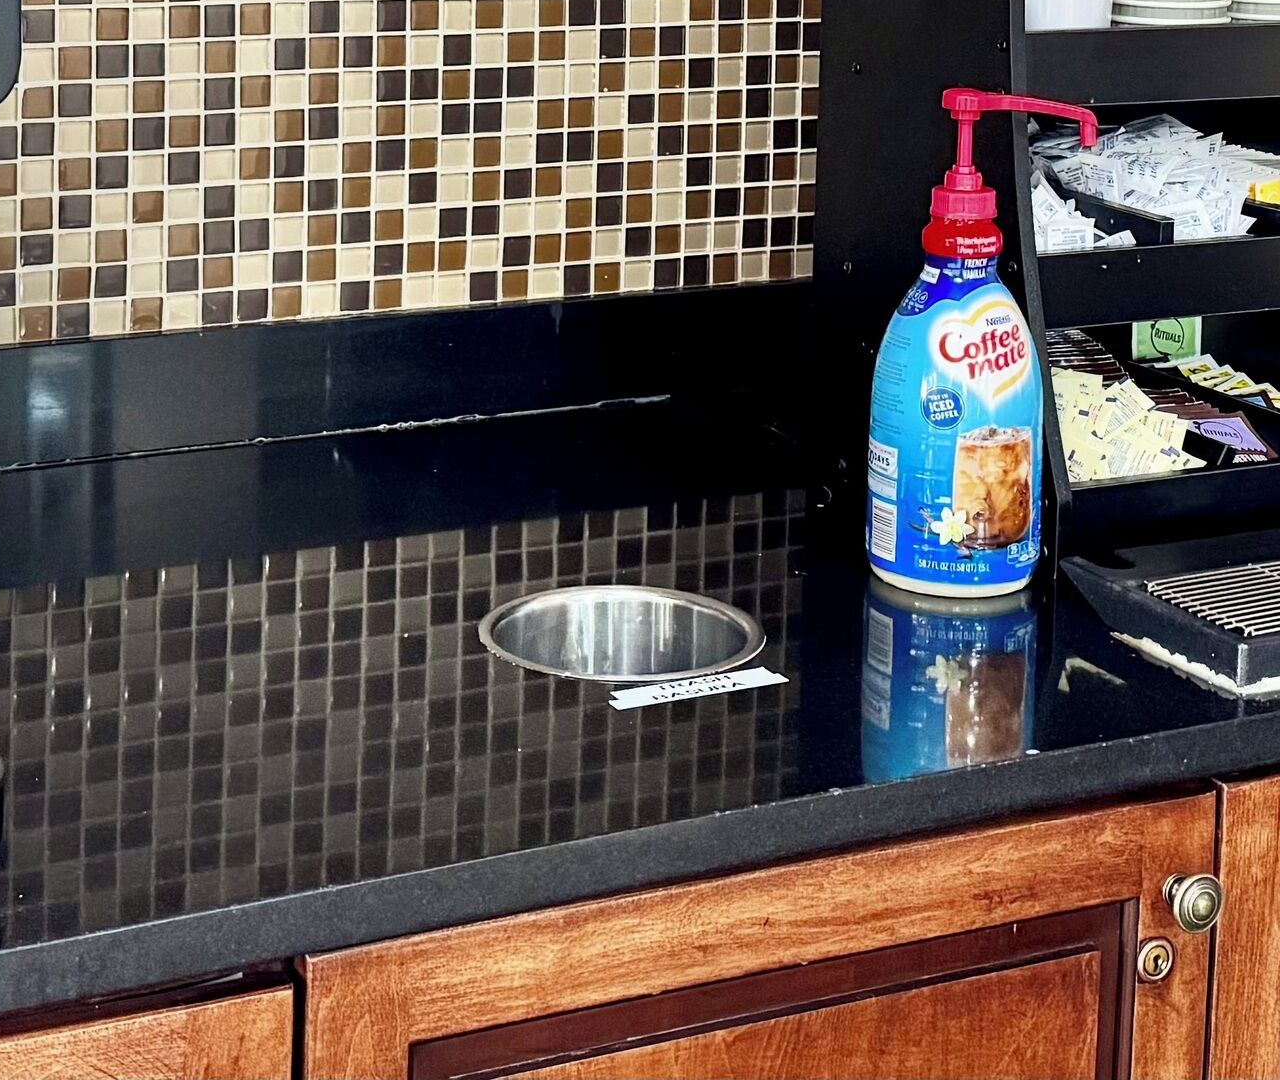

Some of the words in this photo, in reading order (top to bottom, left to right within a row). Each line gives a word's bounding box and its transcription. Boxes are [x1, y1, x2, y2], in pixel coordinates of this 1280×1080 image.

[1154, 327, 1182, 343] RITUALS
[938, 323, 1021, 364] Coffee
[967, 341, 1026, 380] mate
[928, 398, 955, 413] ICED
[930, 409, 959, 421] COFFEE
[1203, 427, 1240, 439] RITUALS
